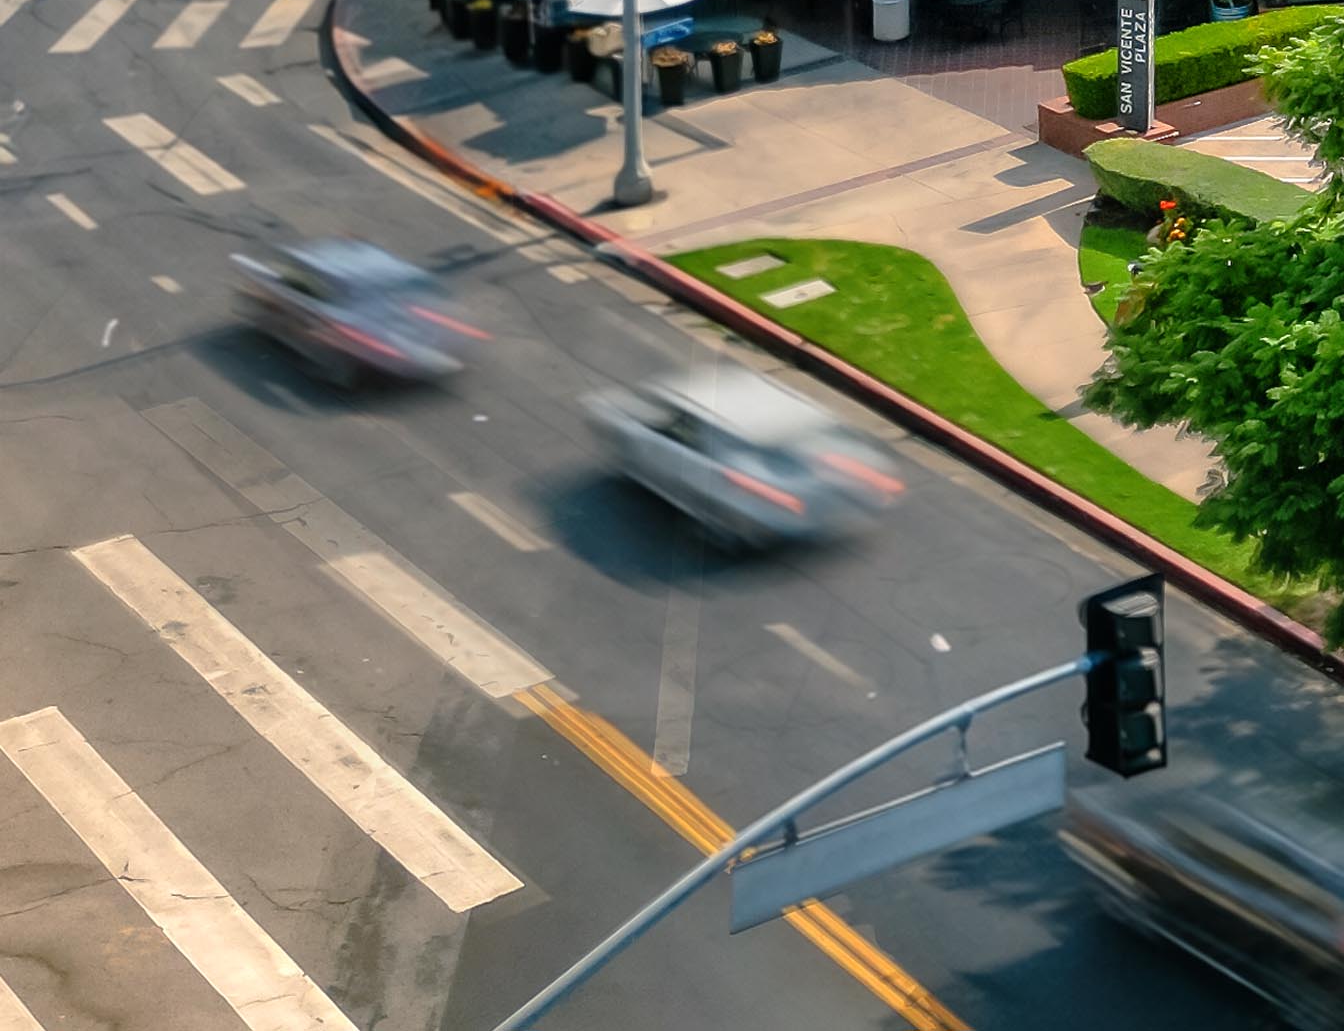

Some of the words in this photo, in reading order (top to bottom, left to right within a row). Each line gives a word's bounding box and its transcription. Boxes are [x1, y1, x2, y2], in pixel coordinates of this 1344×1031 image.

[1120, 8, 1133, 74] VICENTE
[1135, 12, 1147, 63] PLAZA
[1120, 82, 1133, 114] SAN
